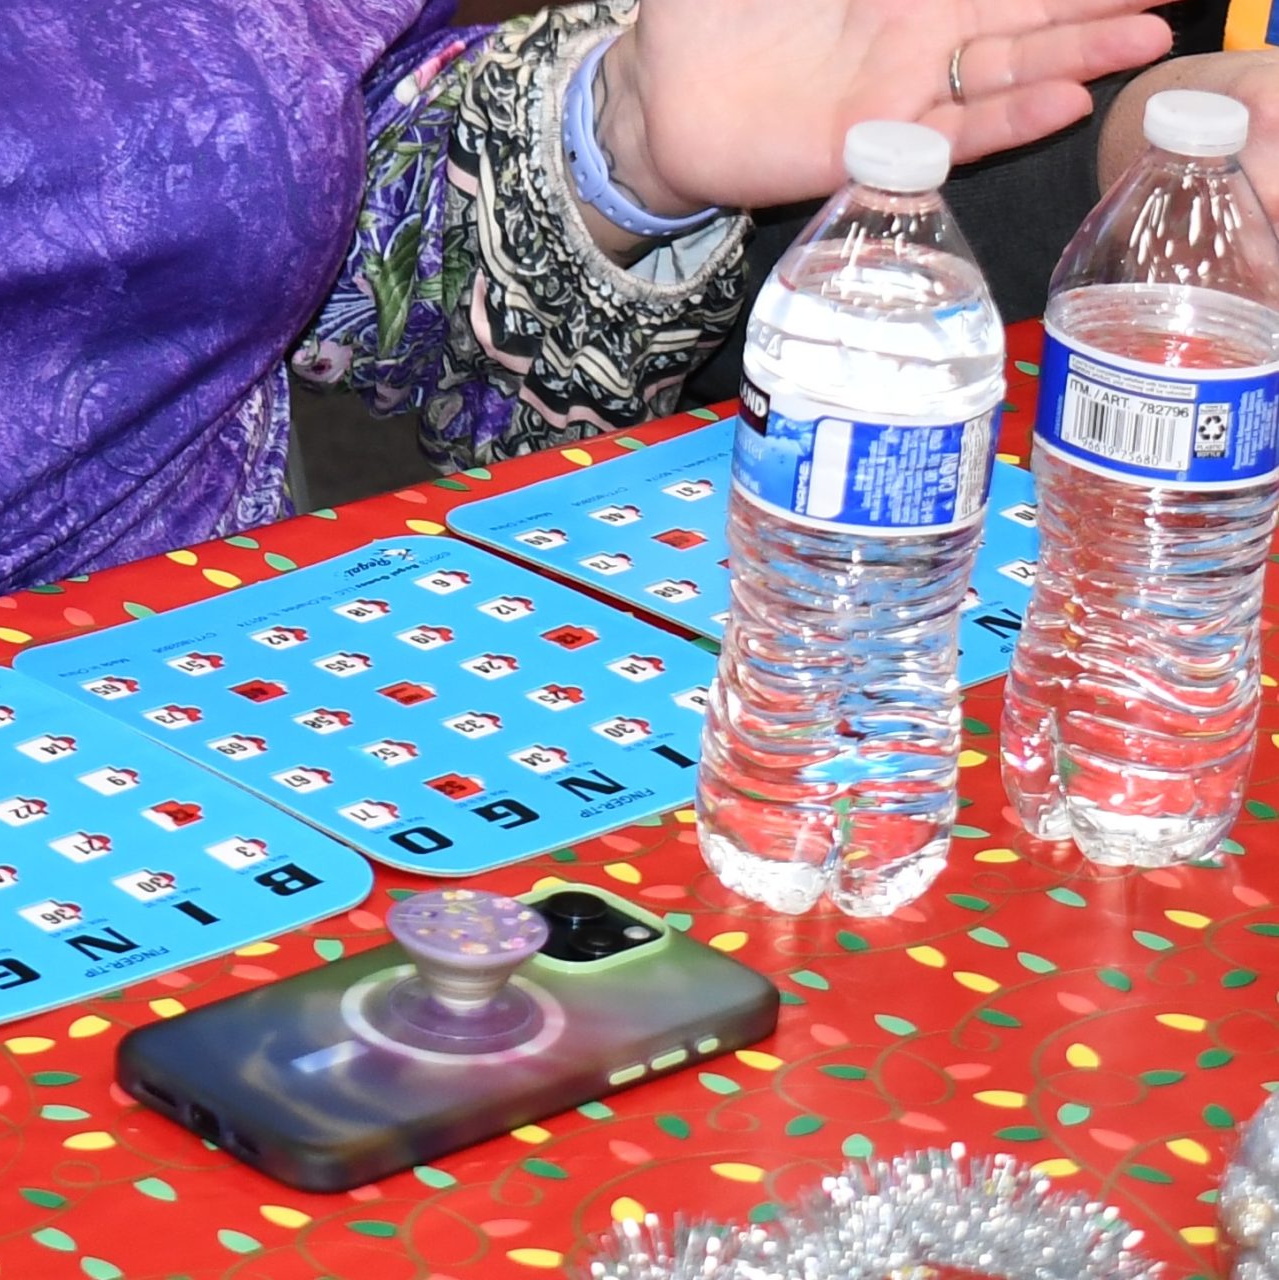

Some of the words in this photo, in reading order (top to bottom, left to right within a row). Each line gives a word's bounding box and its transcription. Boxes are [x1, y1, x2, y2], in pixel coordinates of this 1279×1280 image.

[1069, 380, 1092, 397] ITM.
[1101, 393, 1130, 409] ART.
[1139, 402, 1190, 418] 782796
[1081, 436, 1115, 456] 96619
[524, 535, 552, 546] 69
[431, 579, 451, 588] 6
[653, 586, 683, 598] 68
[347, 607, 373, 617] 18
[490, 605, 518, 615] 12
[972, 608, 1022, 640] N
[262, 633, 291, 645] 42
[409, 634, 437, 645] 19
[177, 660, 205, 672] 51
[324, 660, 355, 672] 35
[473, 660, 502, 674] 24
[620, 663, 647, 675] 14
[90, 683, 121, 696] 65
[537, 690, 568, 704] 25
[154, 714, 186, 724] 73
[303, 716, 334, 730] 58
[454, 719, 484, 733] 33
[603, 724, 635, 738] 30
[40, 743, 70, 755] 14
[216, 742, 248, 755] 69
[522, 752, 551, 767] 34
[650, 744, 698, 769] I
[106, 775, 127, 787] 9
[284, 775, 311, 788] 67
[556, 769, 628, 803] N
[580, 787, 656, 819] FINGER-TIP
[9, 804, 39, 819] 22
[353, 809, 377, 821] 71
[471, 798, 540, 829] G
[73, 838, 103, 856] 21
[389, 826, 453, 855] O
[235, 846, 256, 858] 3
[137, 876, 167, 893] 30
[254, 863, 325, 896] B
[40, 908, 73, 924] 36
[172, 900, 221, 926] I
[65, 927, 141, 961] N
[85, 946, 170, 977] FINGER-TIP
